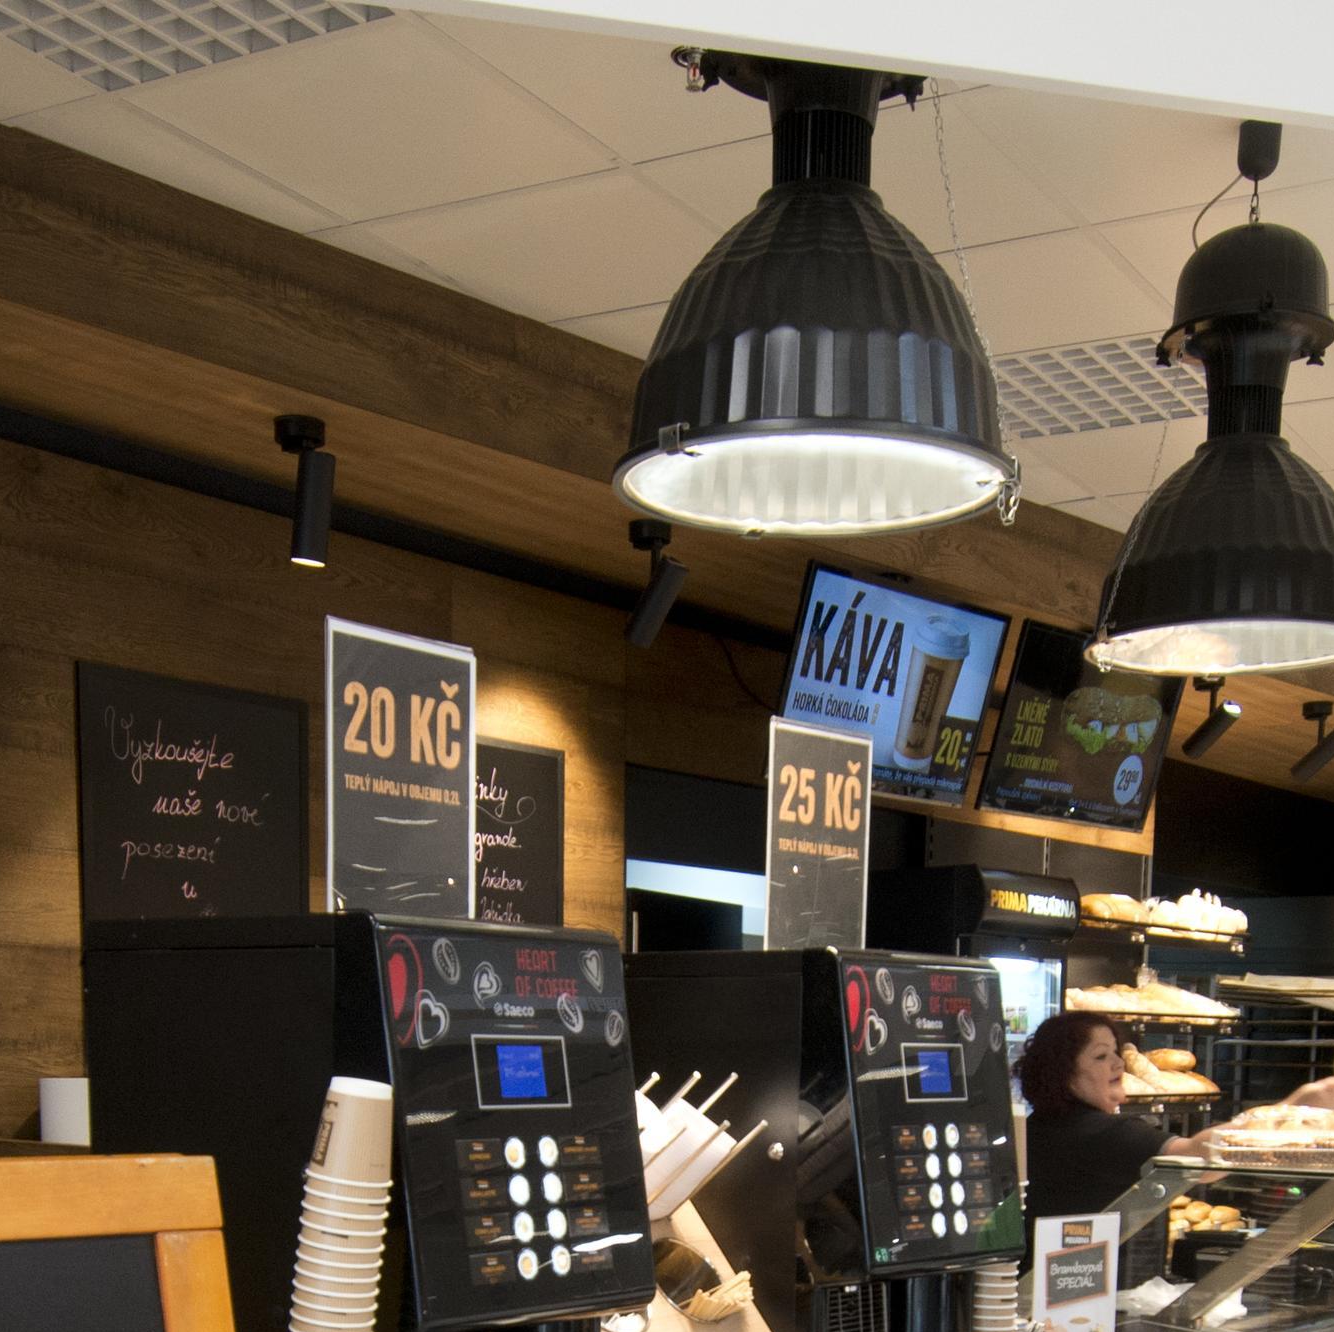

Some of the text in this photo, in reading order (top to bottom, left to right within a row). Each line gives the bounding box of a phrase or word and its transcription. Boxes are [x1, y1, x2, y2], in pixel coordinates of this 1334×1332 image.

[800, 590, 905, 697] KÁVA
[792, 691, 825, 714] HORKÁ
[824, 694, 870, 724] ČOKOLÁDA
[344, 680, 461, 770] 20 KČ
[1010, 722, 1044, 749] ZLATO
[105, 705, 234, 784] Vyzkoušejte
[344, 773, 370, 791] TEPLÝ
[372, 776, 400, 796] NÁPOJ
[779, 760, 861, 831] 25 KČ
[152, 790, 203, 816] naše
[121, 837, 222, 880] posezení
[181, 881, 198, 898] u
[515, 948, 556, 971] HEART
[515, 976, 578, 1001] OF COFFEE
[503, 1003, 535, 1017] Saeco
[1050, 1259, 1103, 1277] Bramborová
